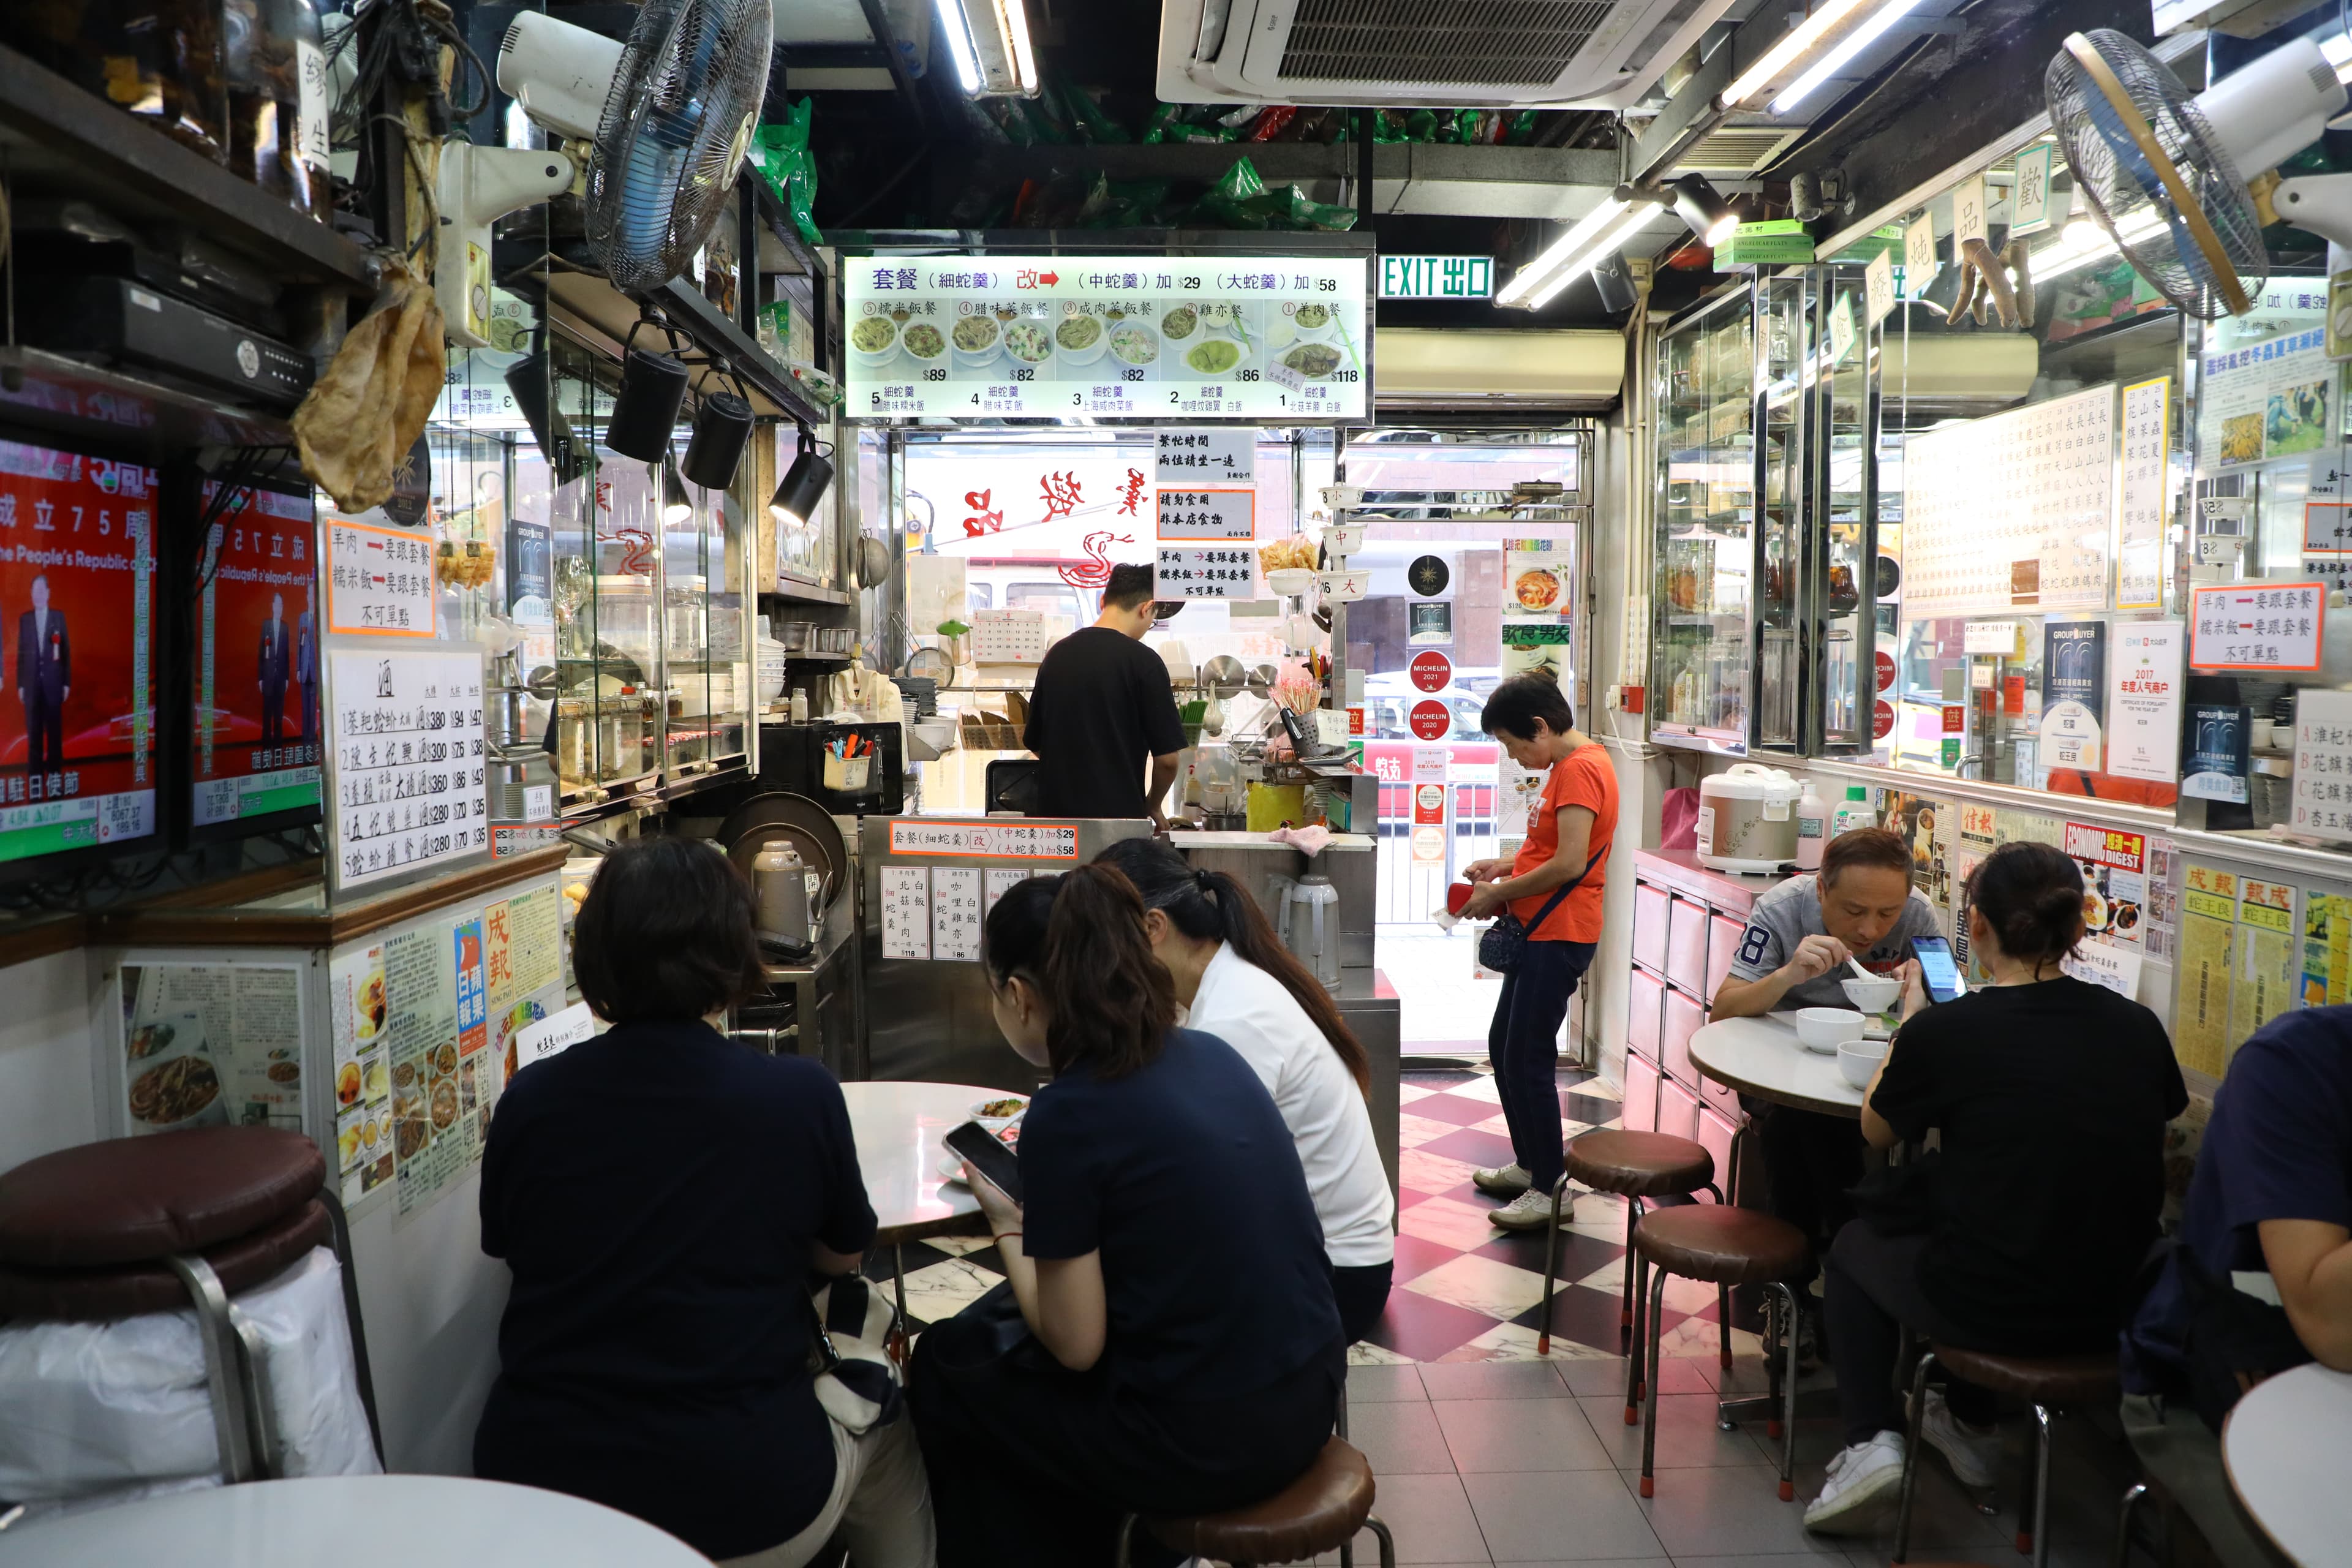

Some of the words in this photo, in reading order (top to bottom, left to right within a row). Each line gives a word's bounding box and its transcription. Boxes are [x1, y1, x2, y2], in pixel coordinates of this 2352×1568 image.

[1959, 202, 1978, 239] 品
[1017, 268, 1038, 290] 改
[1178, 277, 1200, 290] $29
[1314, 278, 1336, 292] $58
[1385, 258, 1438, 295] EXIT
[1443, 258, 1489, 296] 出口
[923, 369, 946, 382] $89
[1009, 369, 1034, 382] $82
[1121, 369, 1144, 382] $82
[1235, 369, 1259, 382] $86
[1331, 370, 1358, 383] $118
[872, 392, 880, 404] 5
[971, 393, 979, 405] 4
[1072, 393, 1081, 405] 3
[1170, 391, 1178, 404] 2
[1280, 394, 1286, 406] 1
[1159, 434, 1208, 447] 繁忙時間
[1159, 494, 1209, 506] 請勿食用
[1335, 530, 1347, 546] 中
[333, 529, 356, 554] 羊肉
[385, 538, 430, 565] 要跟套餐
[1159, 551, 1182, 563] 羊肉
[1205, 551, 1250, 564] 要跟套餐
[1205, 568, 1250, 581] 要跟套餐
[386, 573, 431, 598] 要跟套餐
[1185, 586, 1225, 597] 不可單點
[1341, 578, 1356, 594] 大
[2201, 594, 2226, 611] 羊肉
[2254, 590, 2313, 611] 要跟套餐
[362, 605, 409, 626] 不可單點
[1502, 625, 1570, 643] 飲食男女
[2253, 617, 2312, 637] 要跟套餐
[2225, 645, 2279, 662] 不可單點
[378, 659, 393, 696] 酒
[2136, 670, 2154, 679] 2017
[2121, 681, 2168, 694] 年度人气商户
[426, 712, 445, 728] $380
[451, 710, 464, 726] $94
[470, 710, 481, 725] $47
[2303, 726, 2310, 742] A
[427, 743, 447, 760] $300
[452, 741, 464, 756] $76
[471, 739, 482, 755] $38
[1375, 757, 1400, 769] 的士
[2301, 752, 2309, 769] B
[429, 775, 447, 791] $360
[453, 772, 466, 788] $86
[472, 769, 483, 784] $43
[1376, 769, 1400, 780] TAXI
[2299, 780, 2307, 796] C
[429, 805, 448, 823] $280
[453, 802, 466, 818] $70
[472, 799, 484, 814] $35
[2298, 807, 2306, 823] D
[430, 835, 450, 853] $280
[454, 832, 467, 848] $70
[473, 827, 485, 842] $35
[974, 835, 985, 846] 改
[2067, 826, 2106, 862] ECONOMIC
[2106, 849, 2139, 869] DIGEST
[914, 880, 925, 907] 白飯
[2188, 895, 2231, 918] 蛇王良
[2243, 907, 2290, 929] 蛇王良
[1741, 925, 1770, 965] 8
